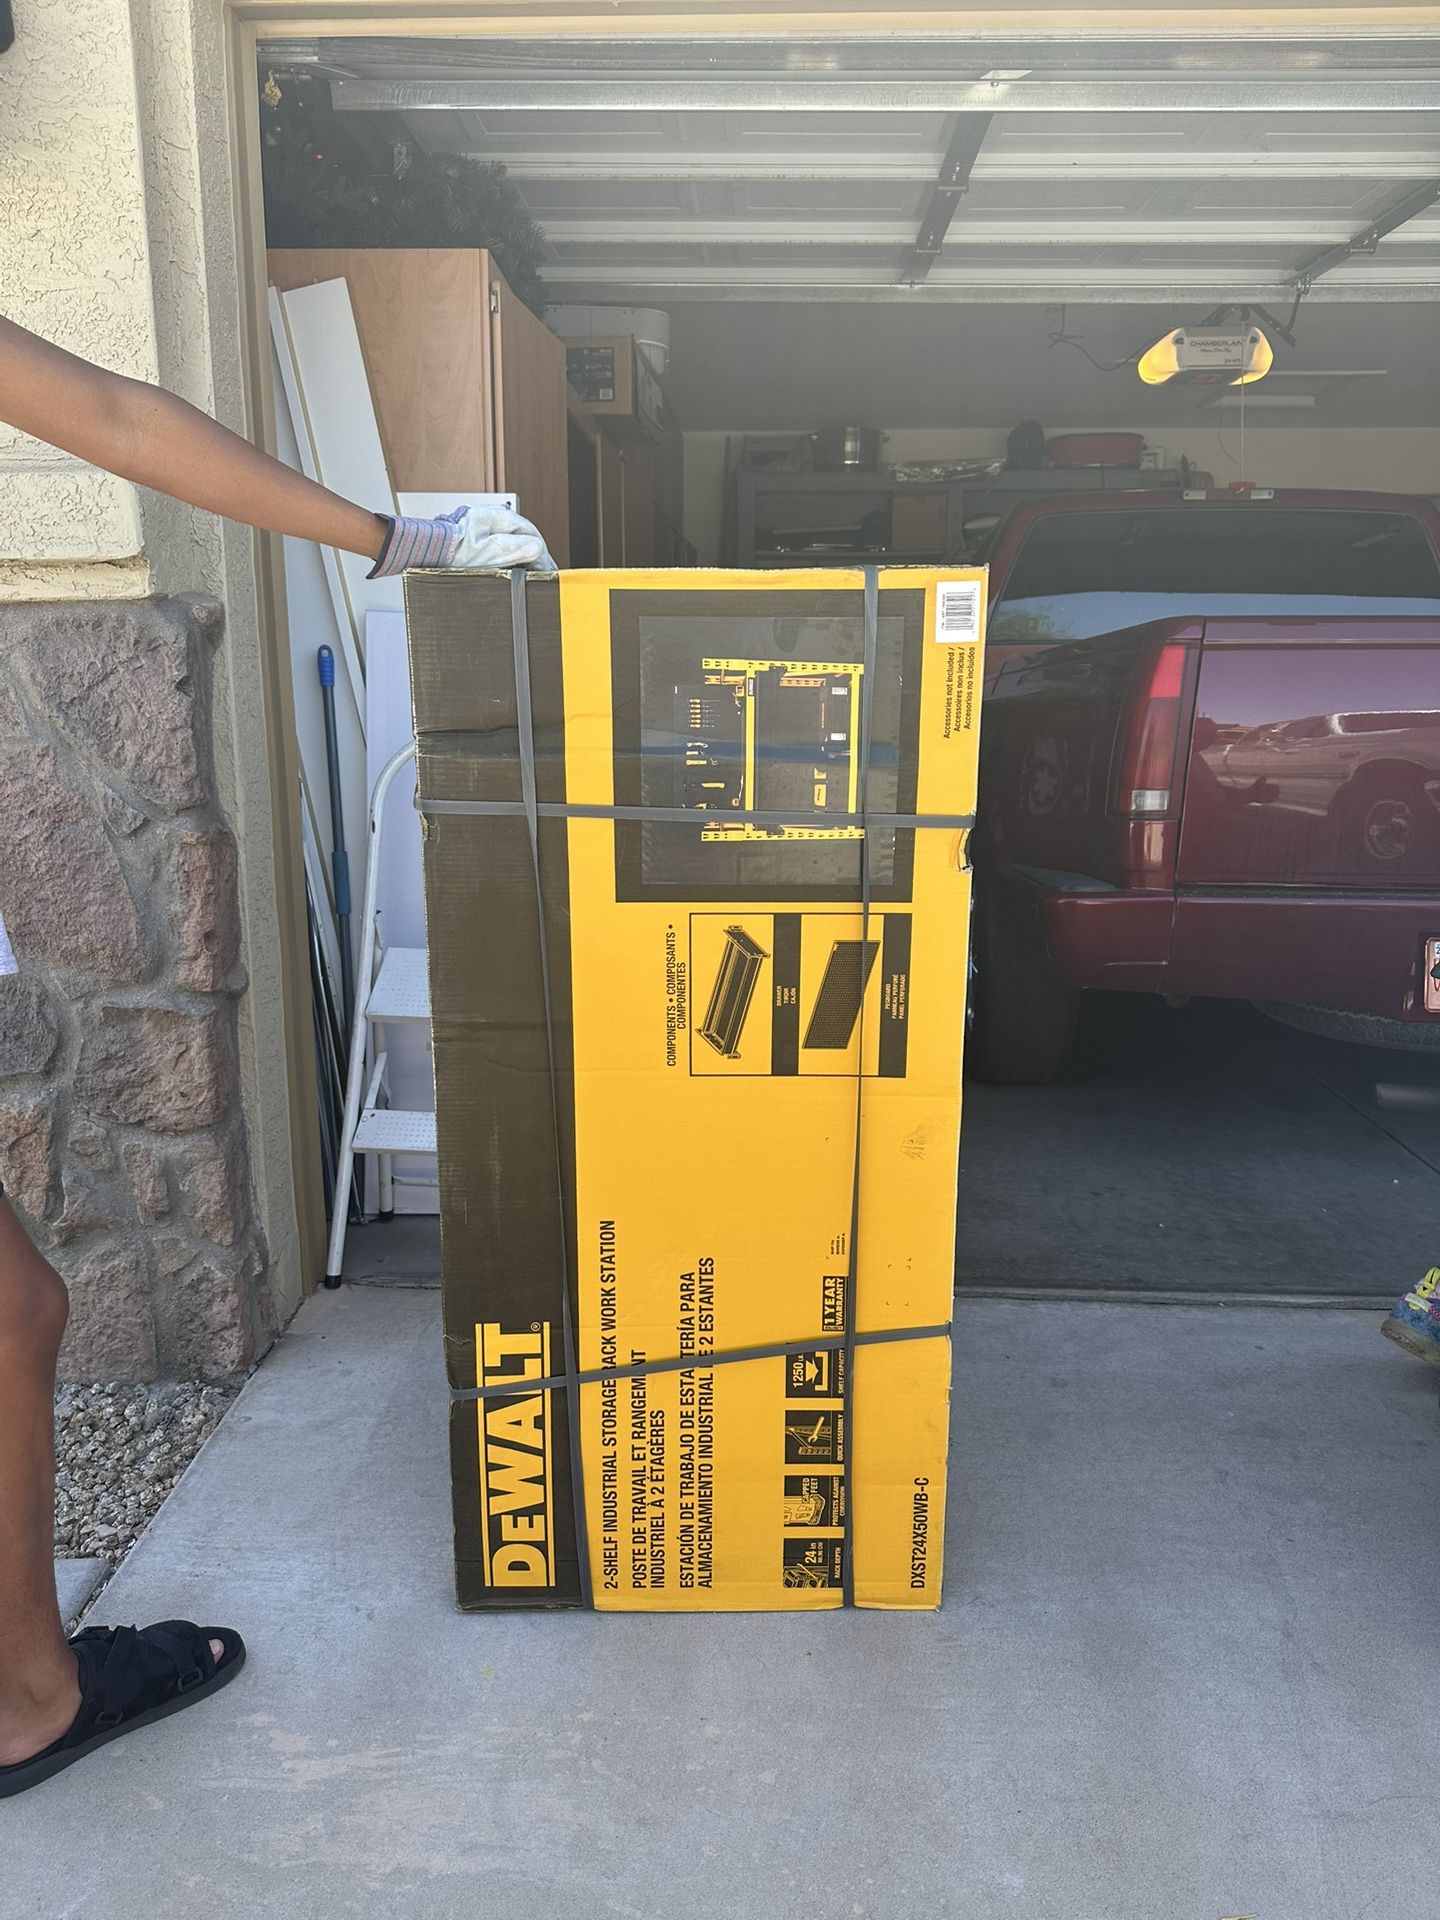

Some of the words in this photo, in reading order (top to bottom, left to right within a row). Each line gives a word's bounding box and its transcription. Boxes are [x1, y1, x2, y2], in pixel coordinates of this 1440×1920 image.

[946, 652, 954, 682] included
[956, 652, 964, 674] inclus
[966, 647, 975, 679] incluidos
[967, 680, 973, 690] no
[944, 698, 952, 738] Accessories
[954, 690, 962, 732] Accessoires
[964, 692, 972, 730] Accesorios
[666, 932, 676, 995] COMPOSANTS
[676, 962, 686, 1030] COMPONENTES
[666, 1006, 676, 1066] COMPONENTS
[600, 1220, 615, 1283] STATION
[601, 1287, 616, 1331] WORK
[680, 1272, 694, 1312] PARA
[699, 1257, 714, 1332] ESTANTES
[825, 1278, 836, 1315] YEAR
[677, 1316, 694, 1406] ESTATERÍA
[699, 1336, 713, 1345] 2
[631, 1349, 646, 1440] RANGEMNT
[793, 1362, 804, 1388] 1250
[602, 1379, 617, 1446] STORAGE
[680, 1410, 694, 1429] DE
[698, 1373, 713, 1458] INDUSTRIAL
[632, 1444, 646, 1461] ET
[647, 1410, 665, 1482] ÉTAGÈRES
[680, 1434, 694, 1498] TRABAJO
[602, 1451, 617, 1532] INDUSTRIAL
[632, 1466, 646, 1523] TRAVAIL
[647, 1498, 664, 1508] À
[650, 1486, 664, 1495] 2
[680, 1502, 694, 1519] DE
[632, 1527, 646, 1544] DE
[698, 1464, 713, 1588] ALMACENAMIENTO
[911, 1478, 929, 1588] DXST24X50WB-C
[603, 1536, 618, 1589] 2-SHELF
[632, 1548, 647, 1588] POSTE
[650, 1512, 665, 1588] INDUSTRIEL
[676, 1524, 694, 1588] ESTACIÓN
[805, 1551, 817, 1564] 24
